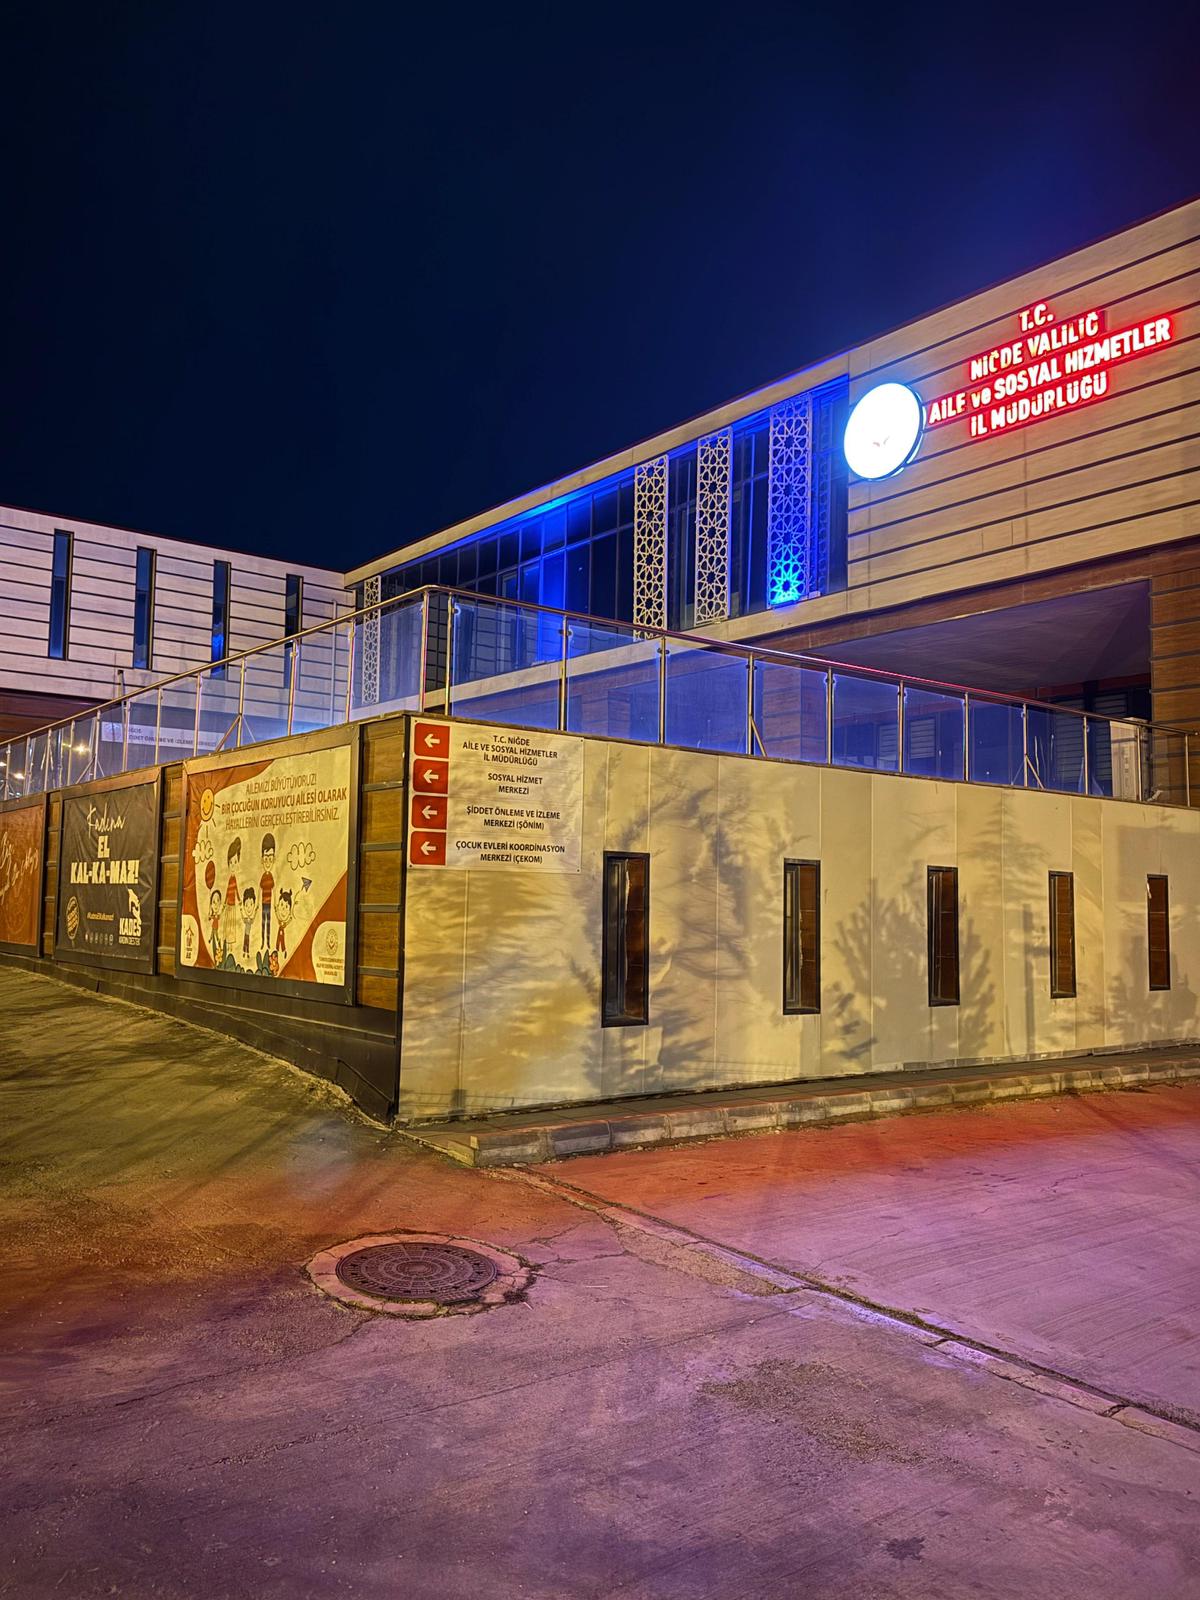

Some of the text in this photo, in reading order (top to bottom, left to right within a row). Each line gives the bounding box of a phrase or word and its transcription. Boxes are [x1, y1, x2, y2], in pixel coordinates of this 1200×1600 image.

[1020, 304, 1053, 331] T.C.
[971, 388, 992, 409] ve
[994, 358, 1062, 400] SOSYAL
[991, 371, 1107, 430] MÜDÜRLÜĞÜ
[493, 735, 530, 746] T.C. NİĞDE
[463, 741, 558, 759] AİLE VE SOSYAL HİZMETLER
[483, 752, 538, 766] İL MÜDÜRLÜĞÜ
[488, 773, 543, 785] SOSYAL HİZMET
[498, 785, 529, 795] MERKEZİ
[231, 798, 260, 816] ÇOCUĞUN
[260, 793, 295, 810] KORUYUCU
[296, 789, 317, 805] AİLESİ
[317, 787, 347, 803] OLARAK
[466, 805, 560, 819] ŞİDDET ÖNLEME VE İZLEME
[483, 819, 544, 831] MERKEZİ (ŞÖNİM)
[97, 835, 110, 858] EL
[456, 841, 565, 853] ÇOCUK EVLERİ KOORDİNASYON
[480, 853, 543, 865] MERKEZİ (ÇEKOM)
[70, 860, 140, 884] KAL-KA-MAZ!
[119, 917, 142, 937] KADES
